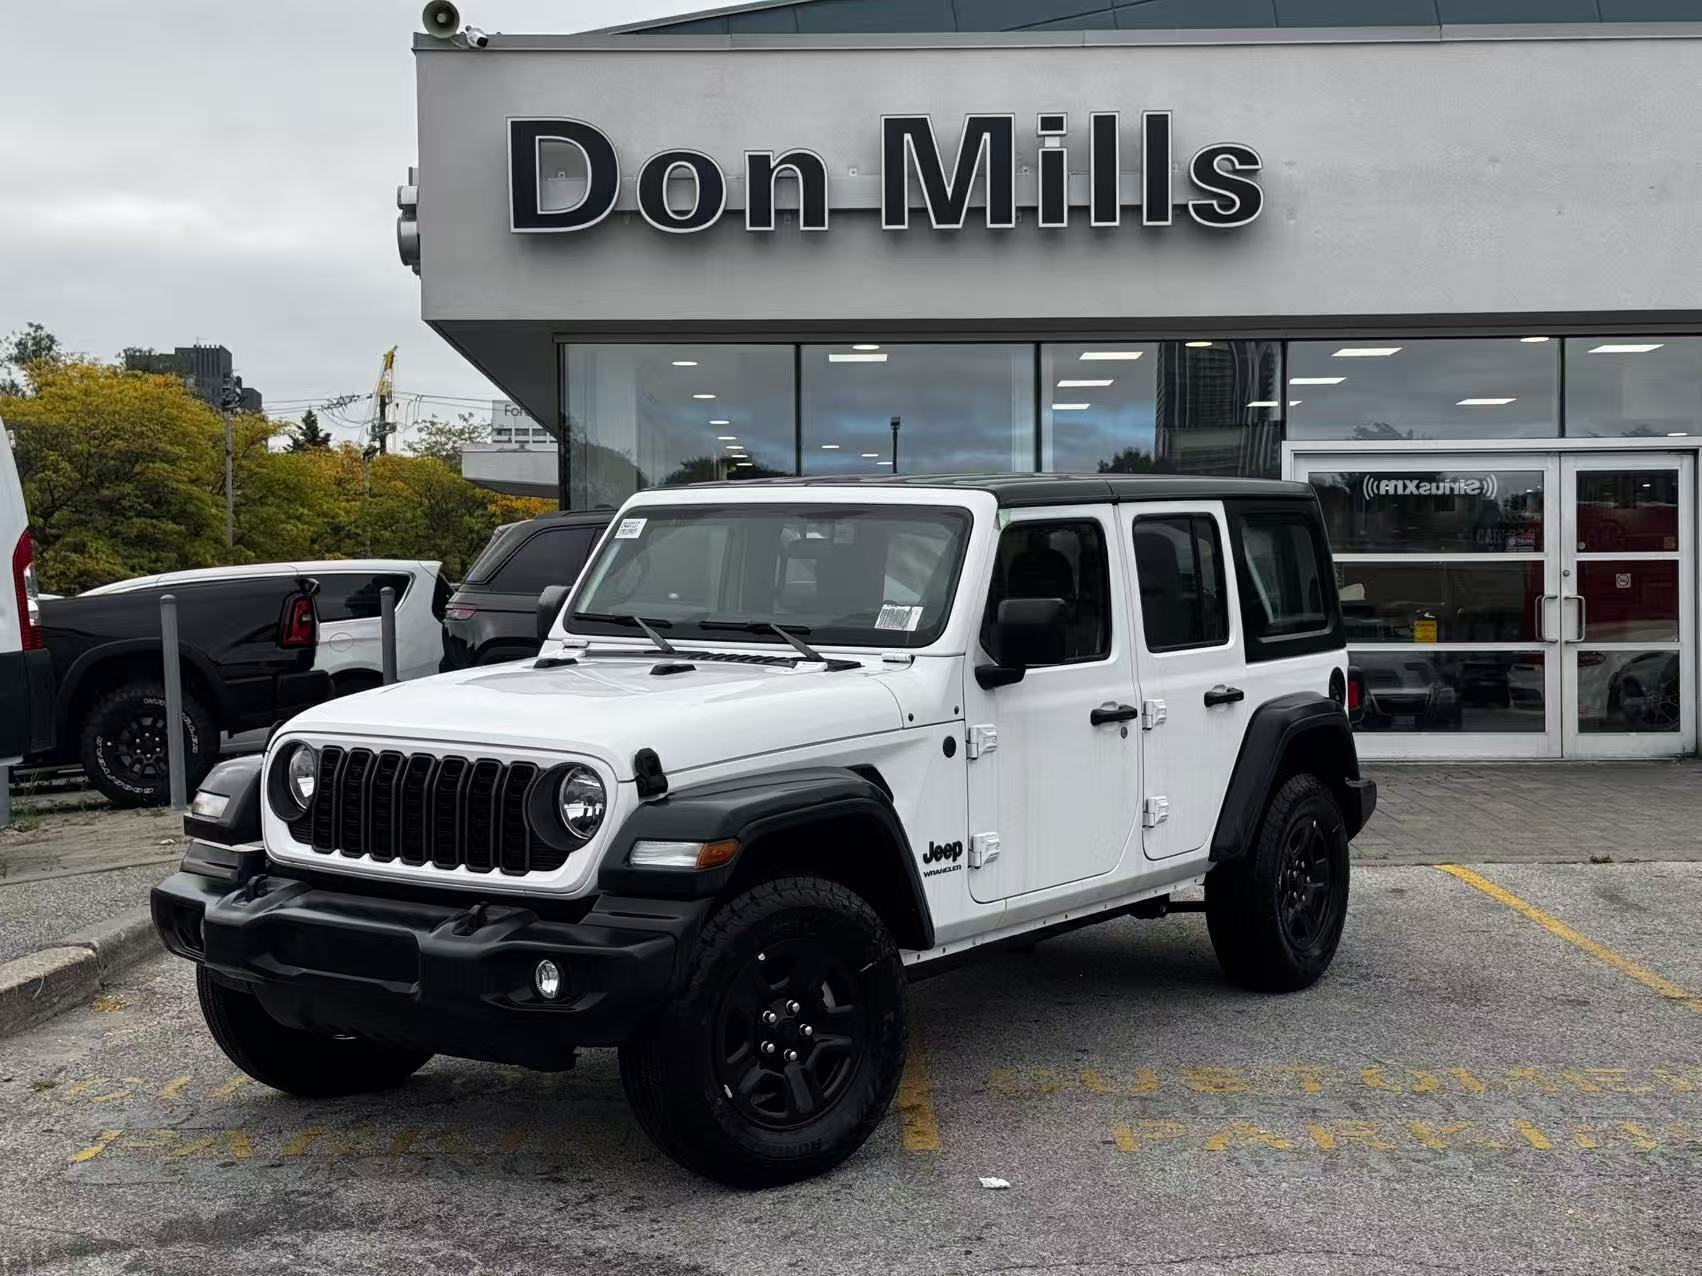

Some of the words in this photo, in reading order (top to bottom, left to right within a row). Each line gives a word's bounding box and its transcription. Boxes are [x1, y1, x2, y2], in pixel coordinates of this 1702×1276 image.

[506, 117, 829, 232] Don
[880, 110, 1263, 229] Mills
[922, 840, 963, 865] Jeep
[923, 864, 962, 878] WRANGLER
